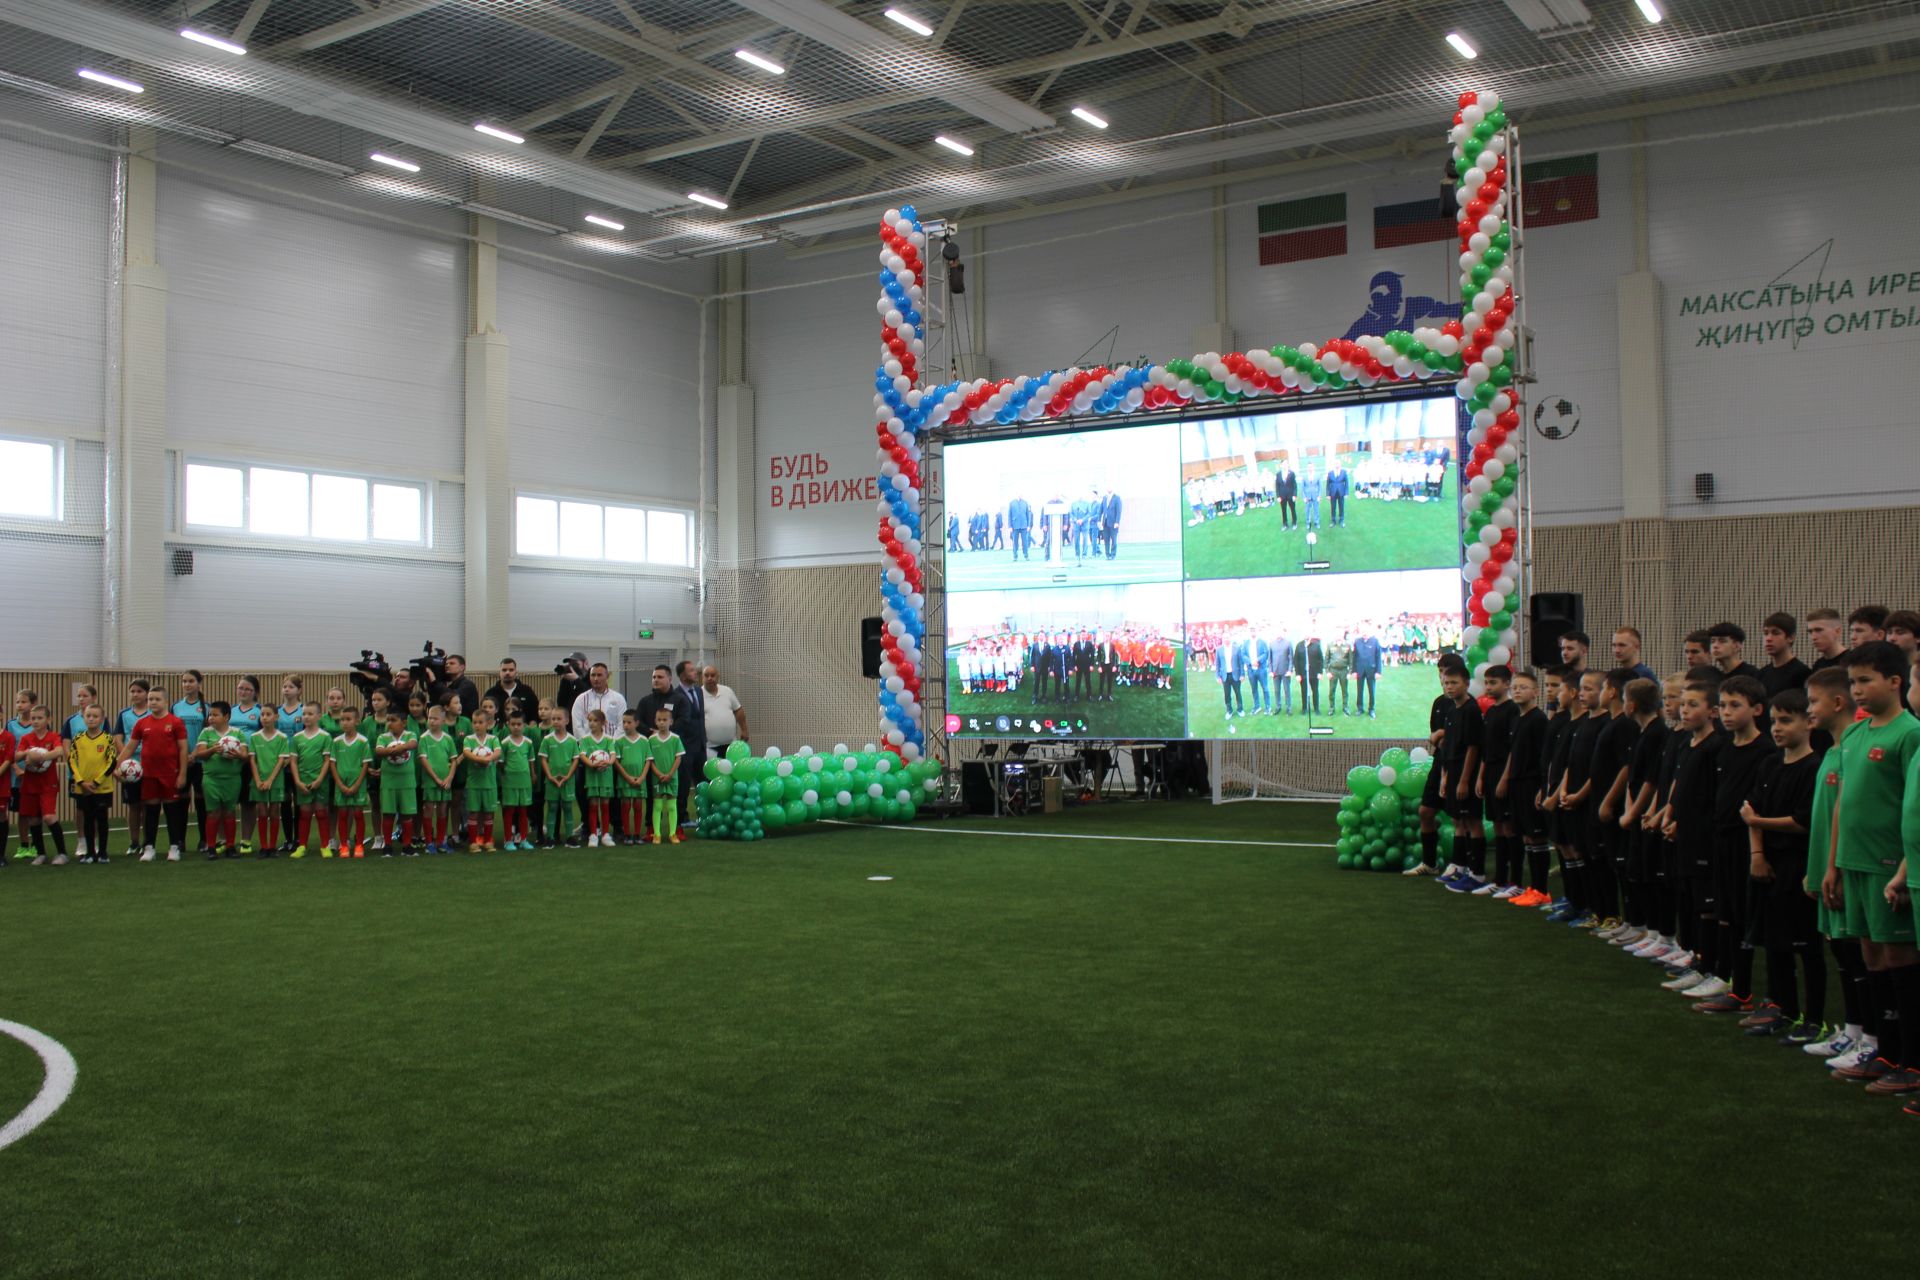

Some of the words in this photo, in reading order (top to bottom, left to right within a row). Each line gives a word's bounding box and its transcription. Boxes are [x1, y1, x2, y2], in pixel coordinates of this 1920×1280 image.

[1680, 280, 1854, 316] МАКСАТЫҢА
[770, 453, 829, 481] БУДЬ
[771, 485, 784, 508] В
